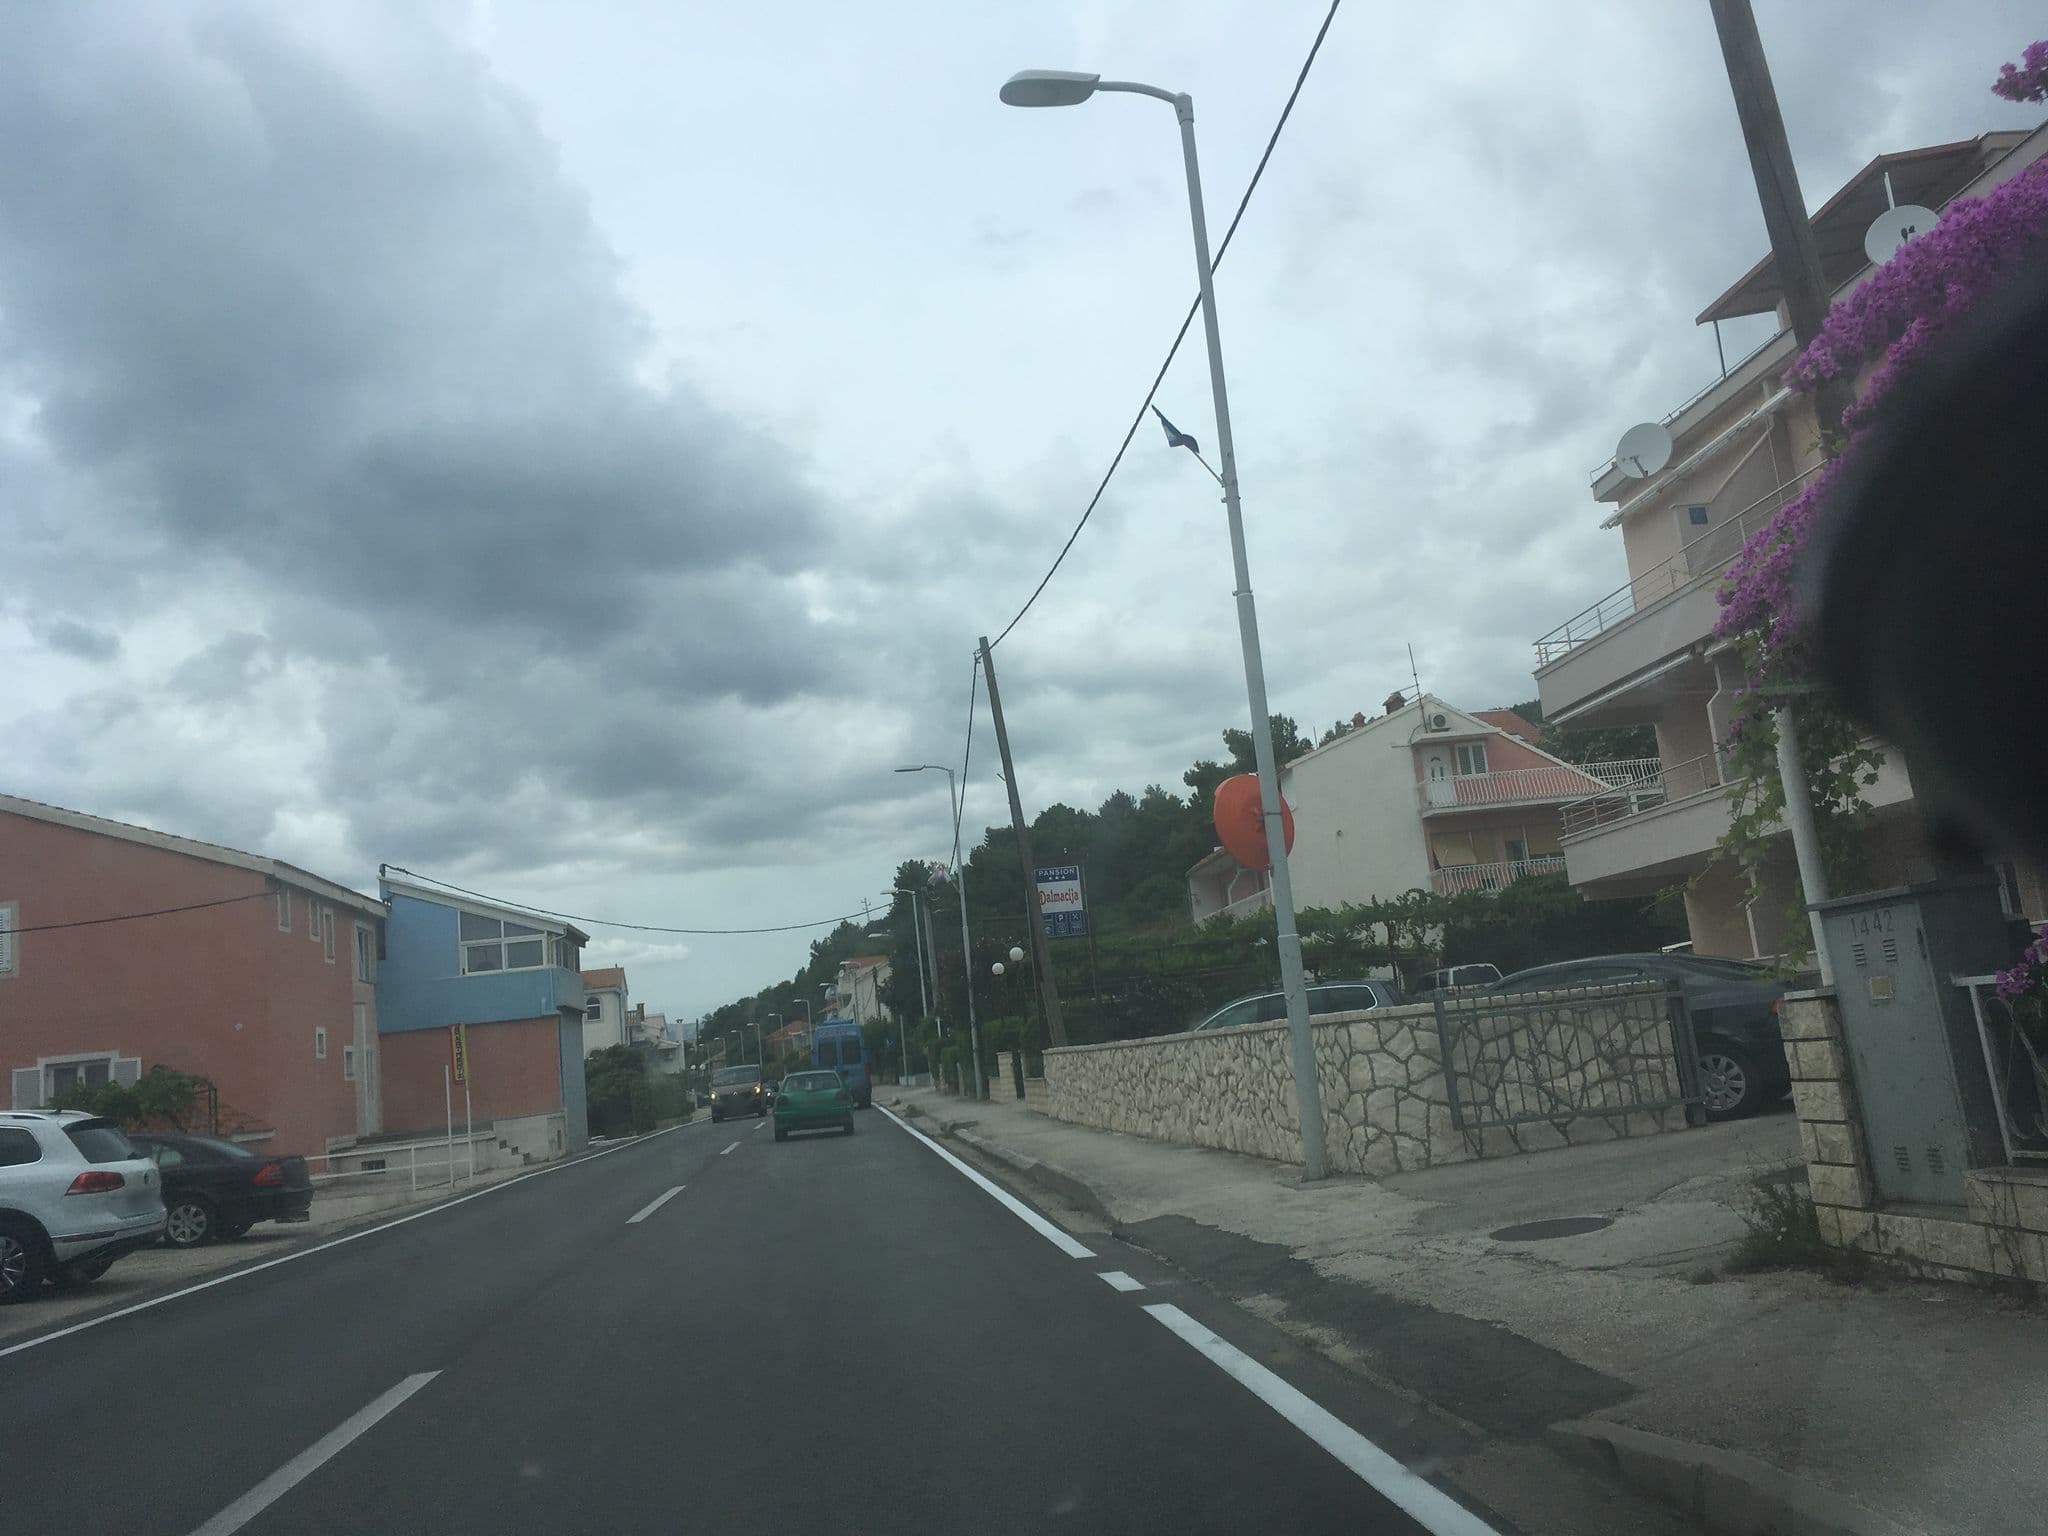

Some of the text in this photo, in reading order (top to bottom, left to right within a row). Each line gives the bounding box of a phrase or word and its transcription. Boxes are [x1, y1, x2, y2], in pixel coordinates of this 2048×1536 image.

[1038, 867, 1075, 877] PANSION
[1039, 888, 1079, 905] Dalmacija
[1850, 909, 1896, 937] 1442
